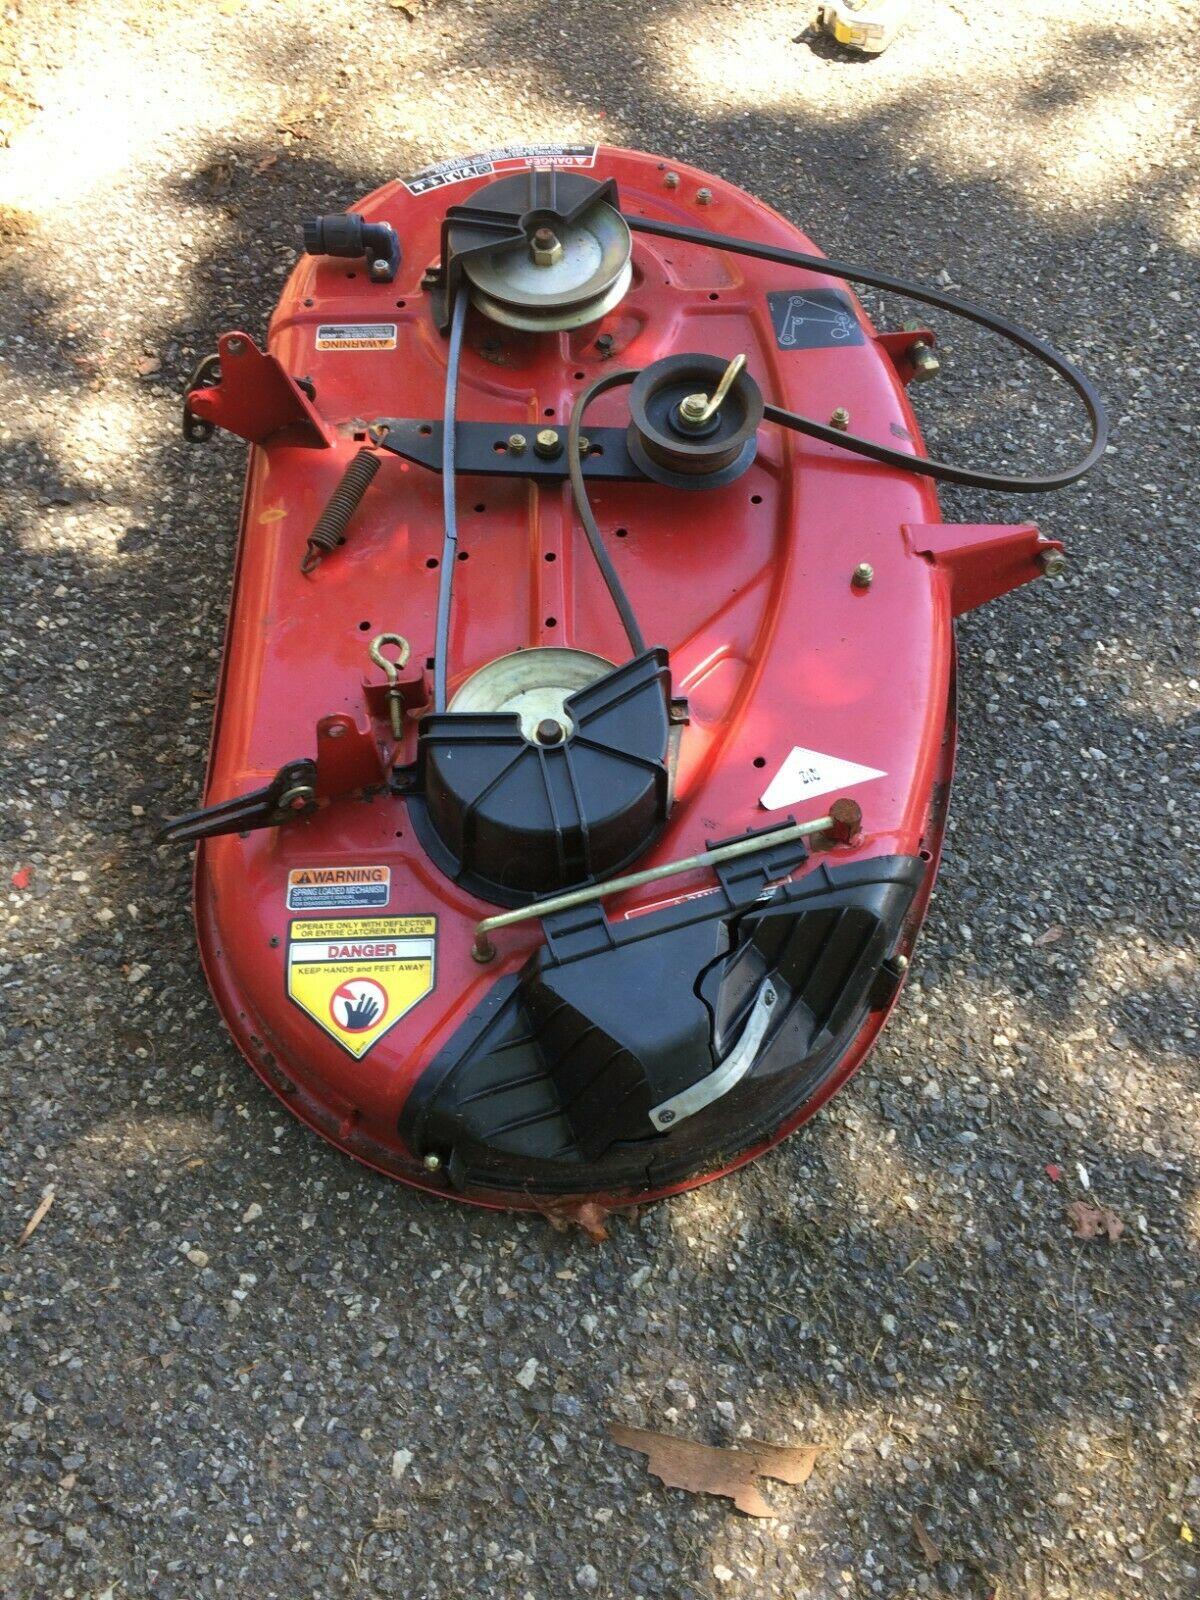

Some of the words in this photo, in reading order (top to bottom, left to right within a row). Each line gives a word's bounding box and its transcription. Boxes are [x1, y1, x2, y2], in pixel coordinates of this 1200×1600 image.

[524, 156, 573, 166] DANGER
[322, 340, 380, 348] WARNING
[313, 869, 382, 883] WARNING
[292, 888, 318, 897] SPRING
[318, 887, 345, 895] LOADED
[346, 885, 385, 894] MECHANISM
[296, 922, 334, 930] OPERATE
[336, 921, 358, 929] ONLY
[361, 920, 381, 928] WITH
[383, 919, 432, 927] DEFLECTOR
[347, 928, 386, 936] CATCHER
[388, 927, 397, 935] IN
[399, 926, 426, 934] PLACE
[328, 943, 397, 959] DANGER
[298, 967, 321, 975] KEEP
[399, 963, 424, 971] AWAY
